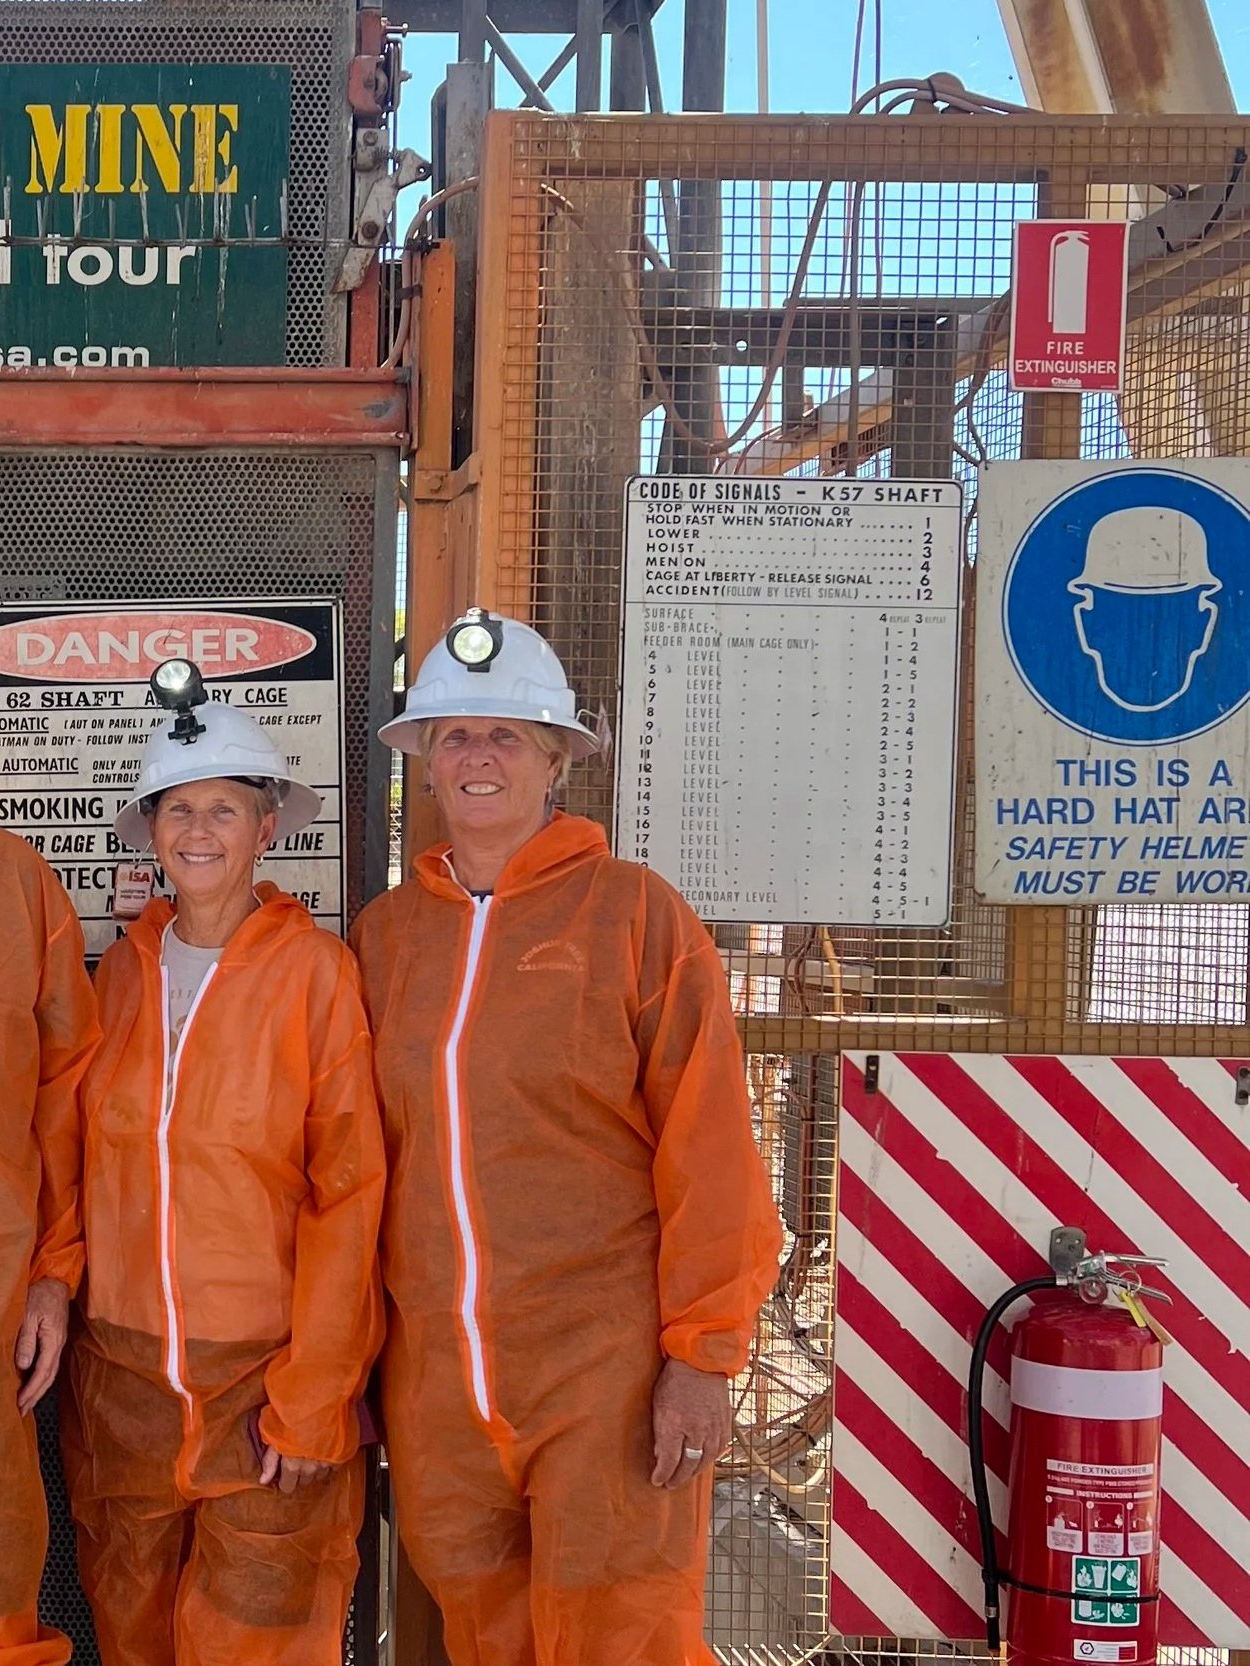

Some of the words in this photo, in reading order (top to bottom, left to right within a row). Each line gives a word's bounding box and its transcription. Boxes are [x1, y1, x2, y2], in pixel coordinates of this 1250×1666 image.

[24, 103, 238, 194] MINE
[43, 233, 196, 285] tour
[1046, 341, 1084, 355] FIRE
[1015, 360, 1117, 375] EXTINGUISHER
[640, 482, 680, 499] CODE
[689, 483, 706, 499] OF
[715, 483, 781, 501] SIGNALS
[874, 488, 943, 503] SHAFT
[647, 503, 682, 513] STOP
[692, 504, 734, 514] WHEN
[743, 505, 758, 515] IN
[765, 505, 821, 516] MOTION
[832, 506, 851, 517] OR
[646, 515, 681, 525] HOLD
[686, 515, 715, 526] FAST
[722, 516, 764, 526] WHEN
[769, 516, 853, 528] STATIONARY
[648, 529, 700, 539] LOWER
[923, 532, 932, 545] 2
[646, 543, 694, 553] HOIST
[922, 546, 932, 559] 3
[646, 557, 678, 567] MEN
[684, 557, 706, 567] ON
[921, 560, 930, 573] 4
[646, 571, 680, 581] CAGE
[685, 571, 700, 581] AT
[704, 571, 756, 582] LIBERTY
[768, 572, 821, 584] RELEASE
[825, 574, 872, 585] SIGNAL
[920, 574, 930, 586] 6
[767, 587, 779, 598] BY
[784, 587, 811, 599] LEVEL
[917, 589, 932, 601] 12
[645, 608, 694, 619] SURFACE
[915, 613, 923, 624] 3
[644, 622, 709, 633] SUB-BRACE
[17, 628, 260, 666] DANGER
[644, 635, 682, 647] FEEDER
[690, 636, 721, 648] ROOM
[760, 638, 782, 650] CAGE
[648, 651, 657, 660] 4
[687, 651, 722, 662] LEVEL
[648, 665, 656, 674] 5
[687, 665, 721, 676] LEVEL
[648, 679, 656, 689] 6
[686, 680, 721, 690] LEVEL
[6, 692, 31, 708] 62
[41, 690, 124, 708] SHAFT
[244, 687, 288, 703] CAGE
[648, 693, 656, 703] 7
[686, 693, 721, 704] LEVEL
[647, 707, 654, 717] 8
[686, 707, 721, 718] LEVEL
[92, 719, 105, 729] ON
[259, 716, 283, 726] CAGE
[287, 715, 322, 725] EXCEPT
[646, 721, 654, 730] 9
[685, 720, 720, 733] LEVEL
[34, 736, 47, 746] ON
[51, 735, 76, 746] DUTY
[86, 734, 124, 745] FOLLOW
[639, 735, 653, 745] 10
[685, 735, 720, 747] LEVEL
[684, 750, 720, 761] LEVEL
[2, 757, 79, 772] AUTOMATIC
[92, 759, 116, 770] ONLY
[684, 763, 720, 775] LEVEL
[92, 773, 140, 784] CONTROLS
[1056, 759, 1137, 787] THIS
[1158, 759, 1190, 787] IS
[1208, 760, 1233, 787] A
[638, 777, 651, 787] 13
[683, 778, 720, 789] LEVEL
[637, 791, 651, 801] 14
[682, 792, 719, 803] LEVEL
[637, 806, 650, 815] 15
[682, 806, 719, 817] LEVEL
[997, 798, 1095, 825] HARD
[1115, 797, 1181, 825] HAT
[636, 820, 650, 829] 16
[681, 820, 718, 831] LEVEL
[51, 834, 96, 854] CAGE
[284, 833, 324, 851] LINE
[636, 833, 650, 843] 17
[681, 834, 718, 845] LEVEL
[636, 847, 649, 858] 18
[680, 848, 718, 859] LEVEL
[1005, 836, 1129, 861] SAFETY
[1140, 836, 1250, 860] HELME
[680, 862, 718, 874] LEVEL
[128, 870, 150, 882] ISA
[679, 876, 717, 887] LEVEL
[1014, 870, 1106, 894] MUST
[1117, 870, 1161, 894] BE
[1177, 870, 1250, 894] WOR
[746, 892, 778, 903] LEVEL
[1057, 1463, 1079, 1473] FIRE
[1081, 1466, 1147, 1476] EXTINGUISHER
[1075, 1490, 1132, 1500] INSTRUCTIONS
